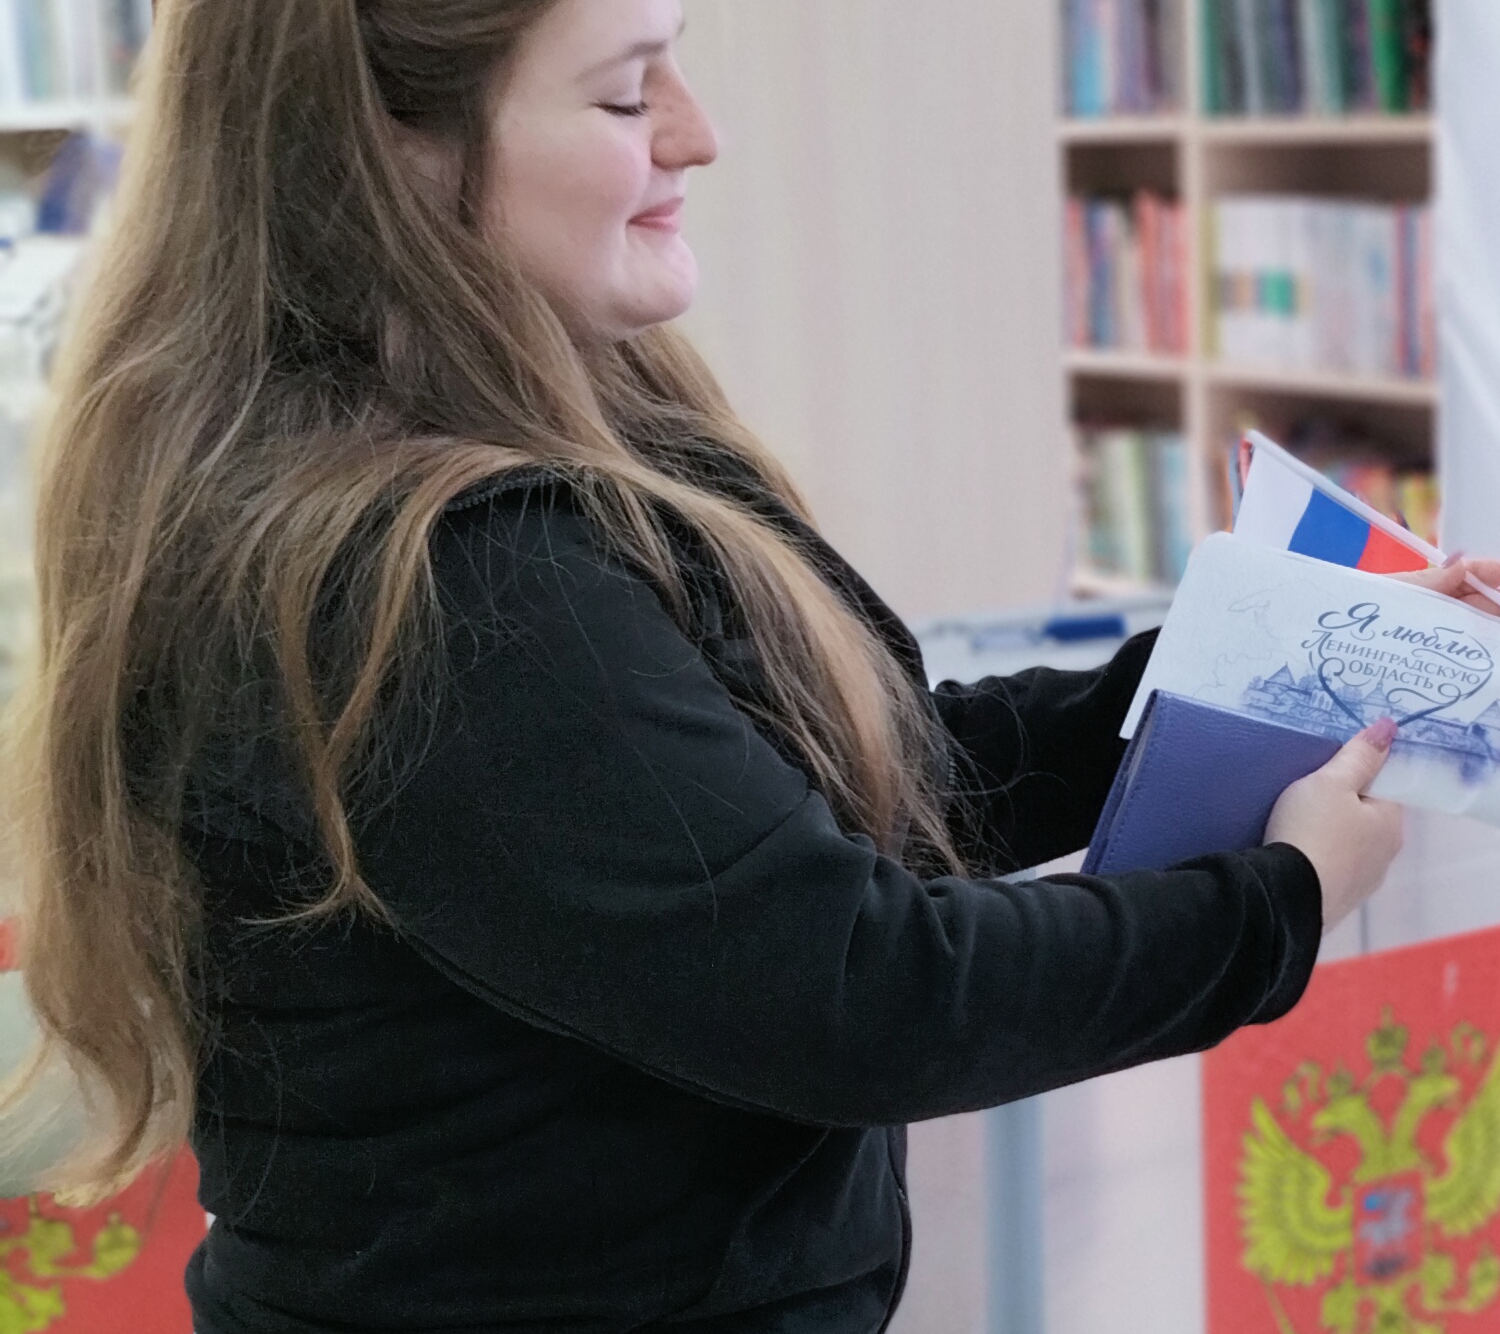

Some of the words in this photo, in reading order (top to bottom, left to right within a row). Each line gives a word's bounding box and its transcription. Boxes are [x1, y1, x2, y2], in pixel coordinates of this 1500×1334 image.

[1317, 602, 1381, 638] Я
[1381, 626, 1491, 667] люблю
[1348, 659, 1434, 690] ОБЛАСТЬ
